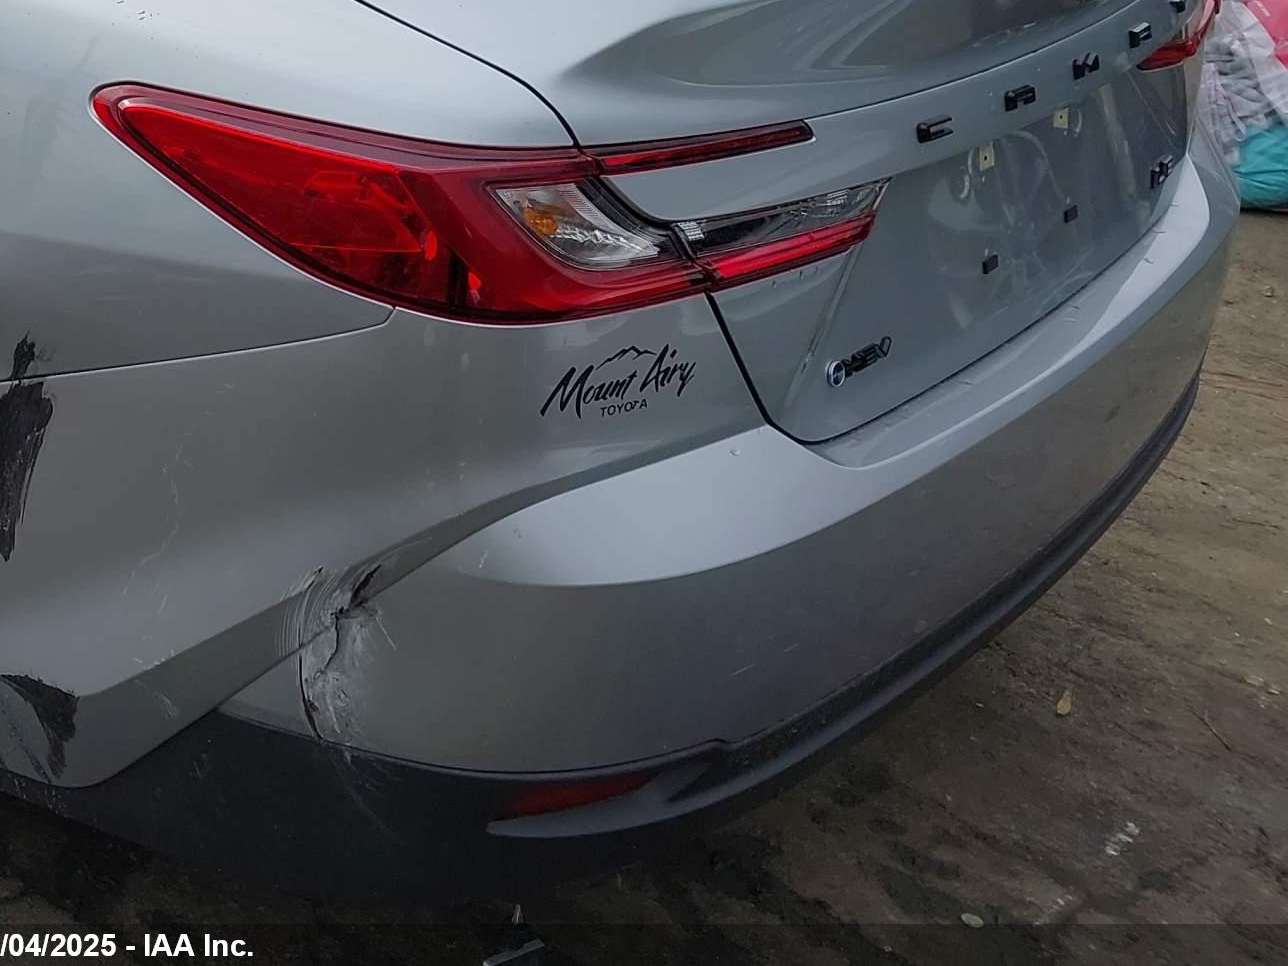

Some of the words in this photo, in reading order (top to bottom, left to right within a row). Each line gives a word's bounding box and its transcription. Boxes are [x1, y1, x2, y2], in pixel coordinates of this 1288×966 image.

[540, 365, 638, 419] Mount
[639, 344, 697, 397] Airy
[600, 399, 648, 417] TOYOTA
